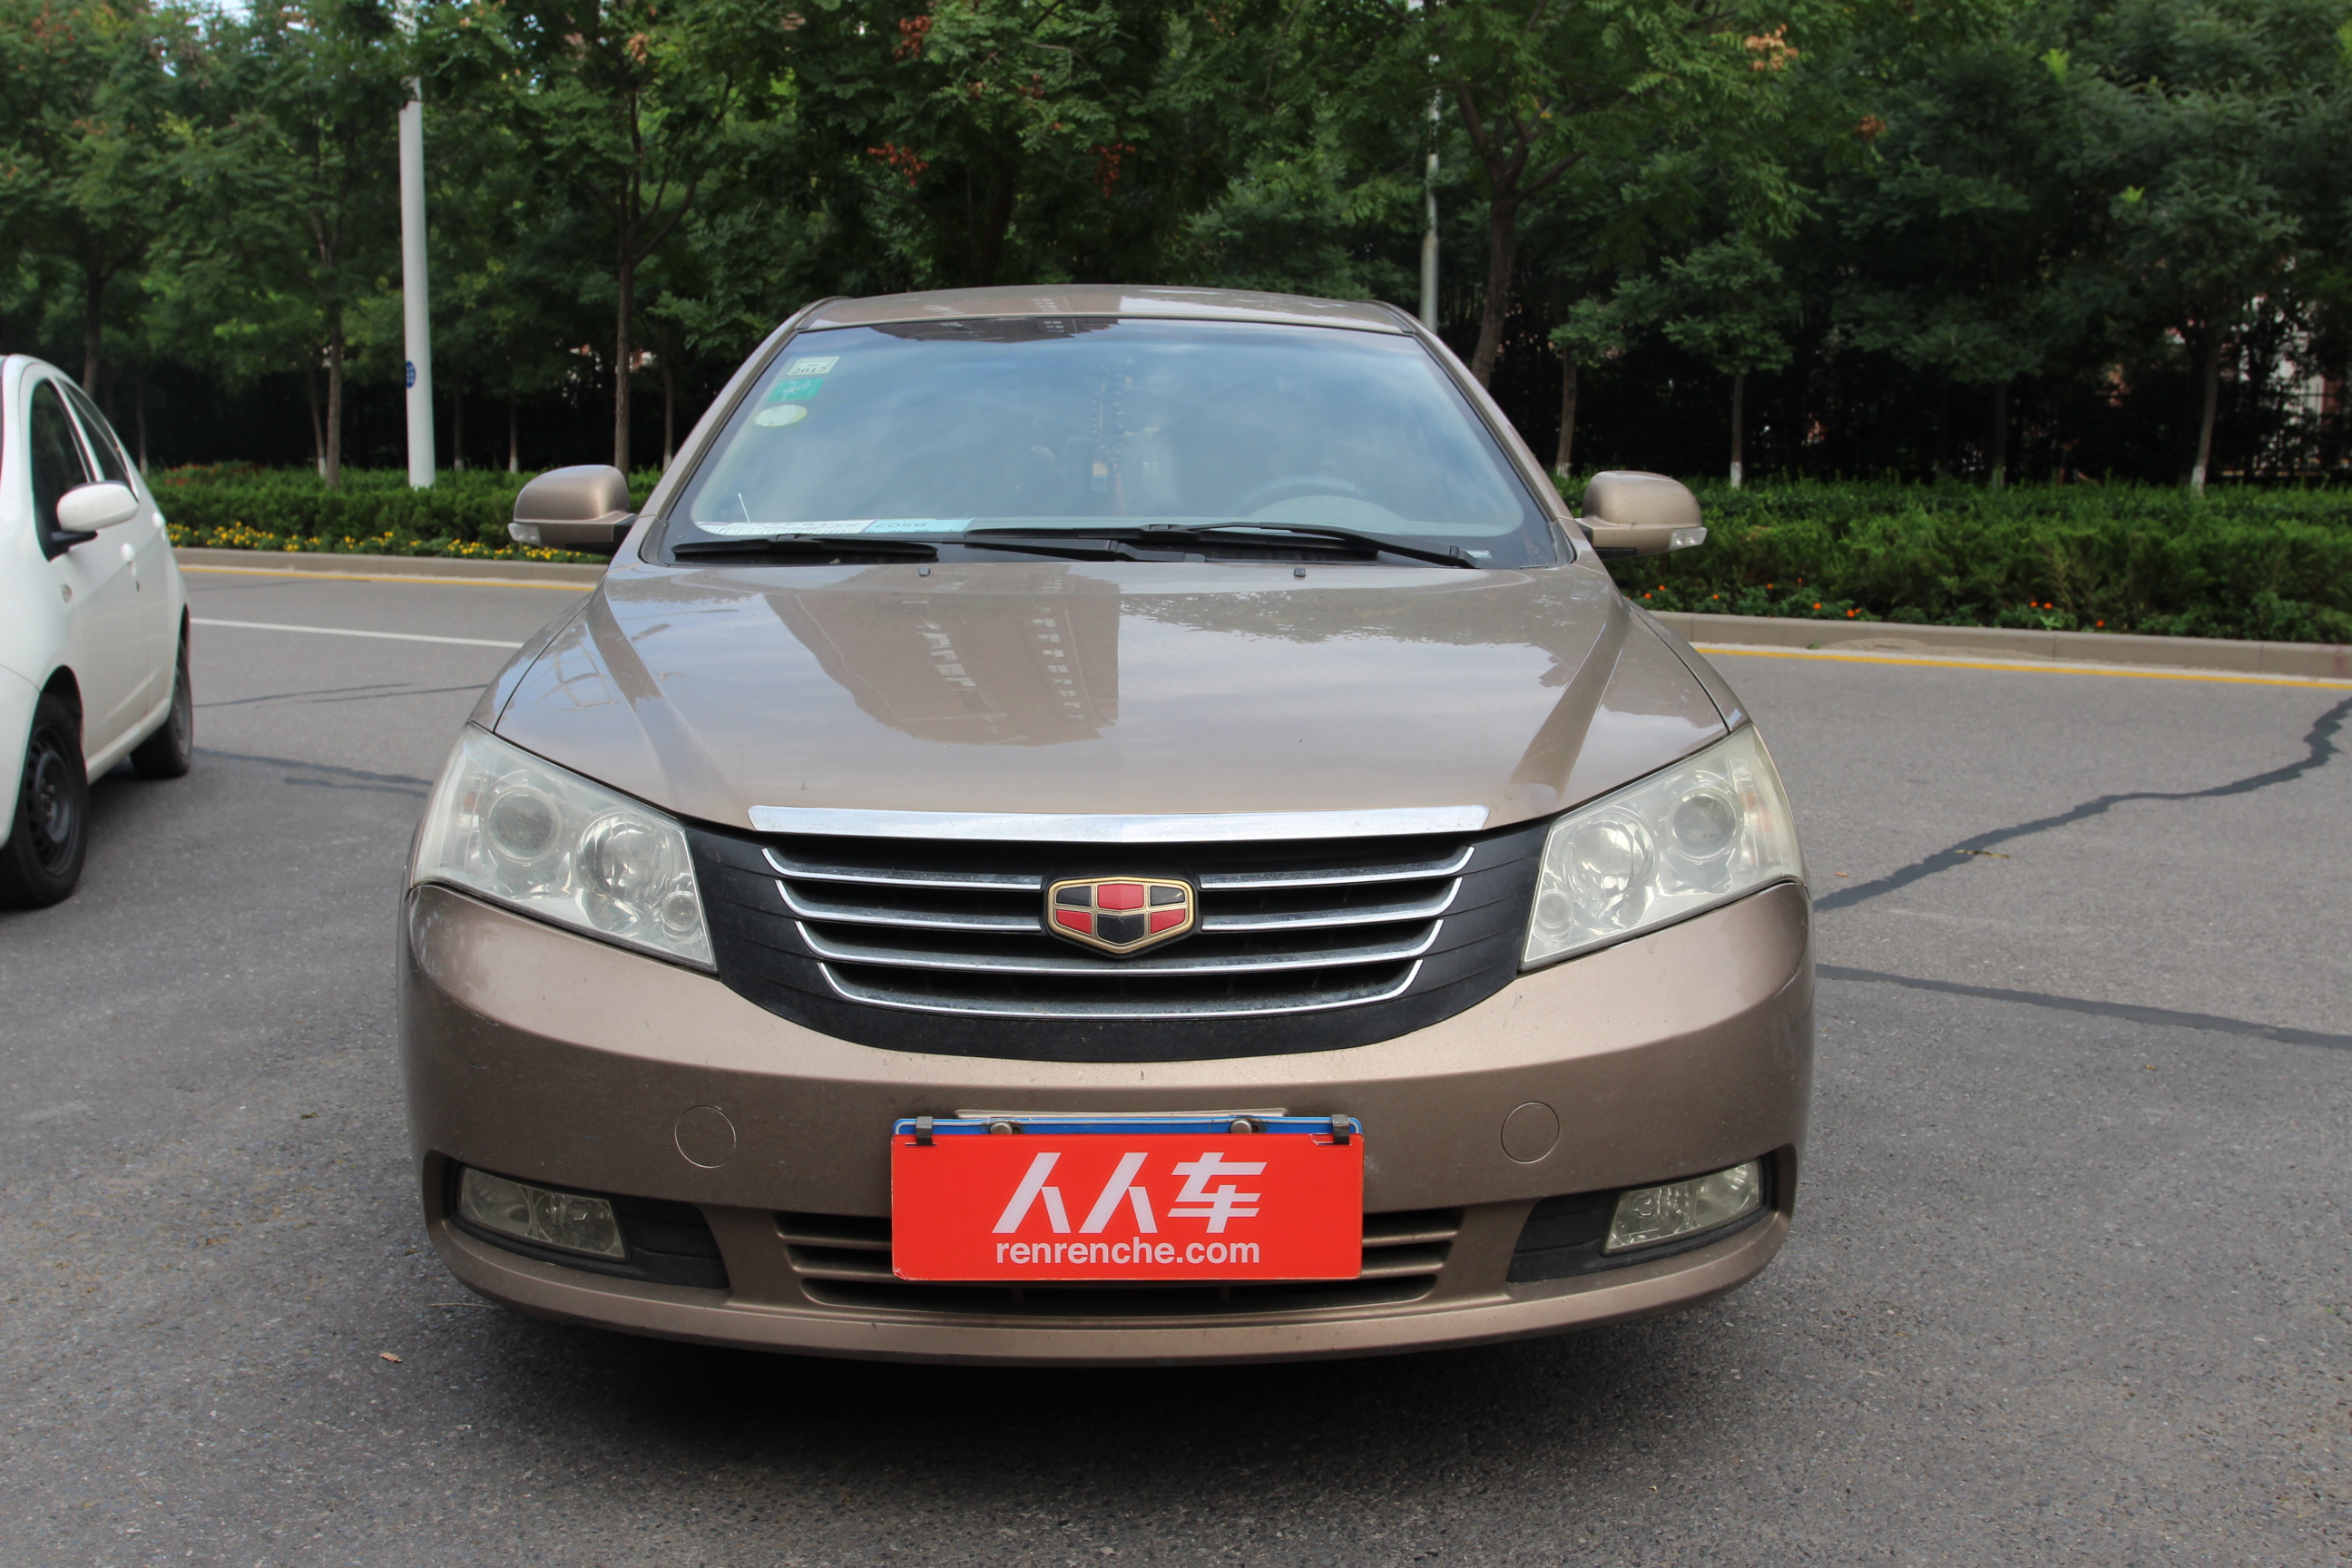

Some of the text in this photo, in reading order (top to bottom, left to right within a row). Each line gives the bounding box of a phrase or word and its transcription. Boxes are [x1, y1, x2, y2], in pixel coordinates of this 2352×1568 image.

[992, 1152, 1268, 1234] 人人车
[996, 1237, 1260, 1264] renrenche.com
